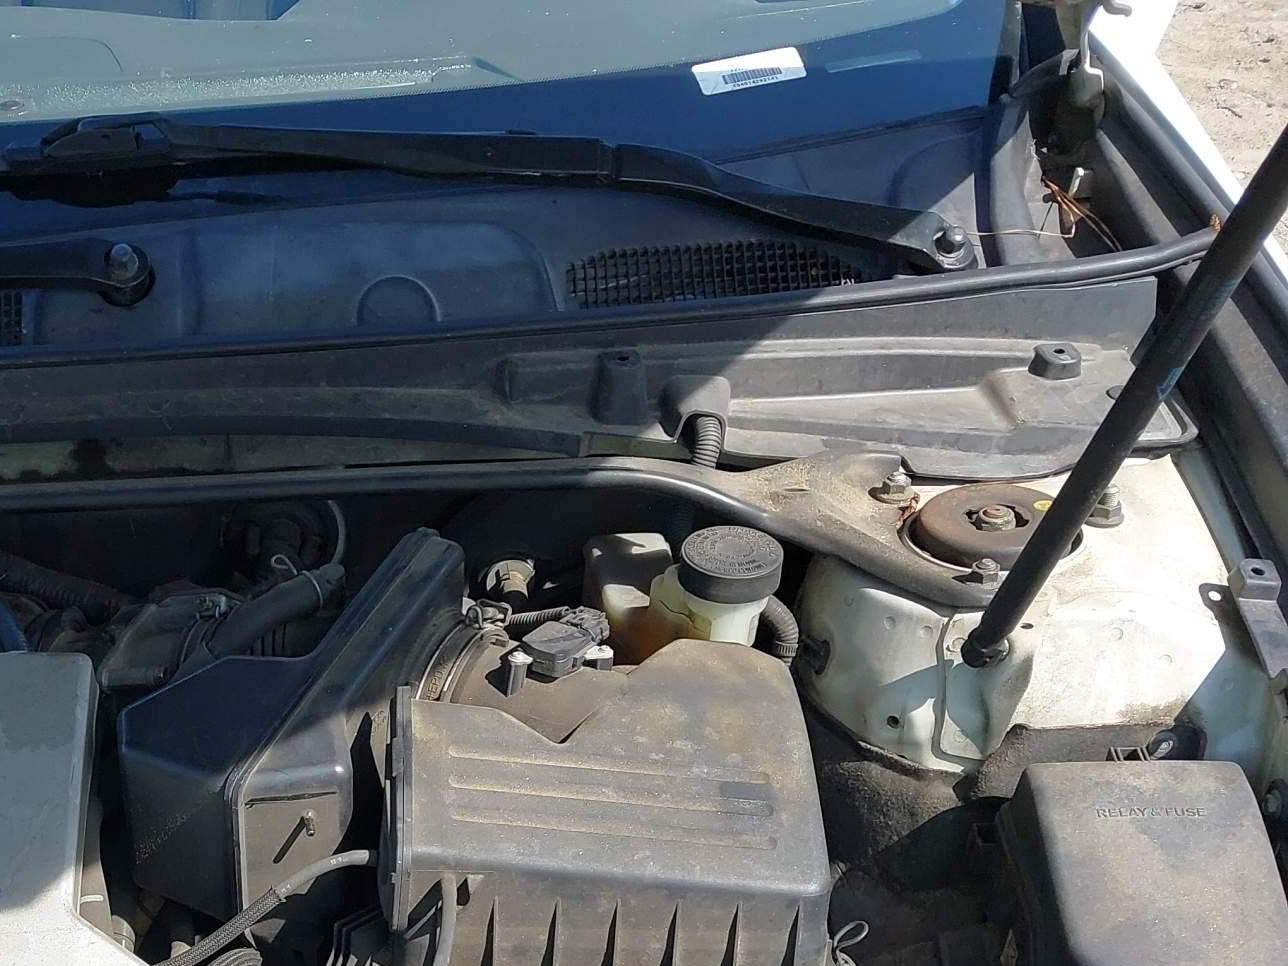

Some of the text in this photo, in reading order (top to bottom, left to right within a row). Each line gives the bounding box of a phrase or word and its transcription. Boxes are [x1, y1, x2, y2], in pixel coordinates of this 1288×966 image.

[1095, 807, 1207, 818] RELAY & FUSE
